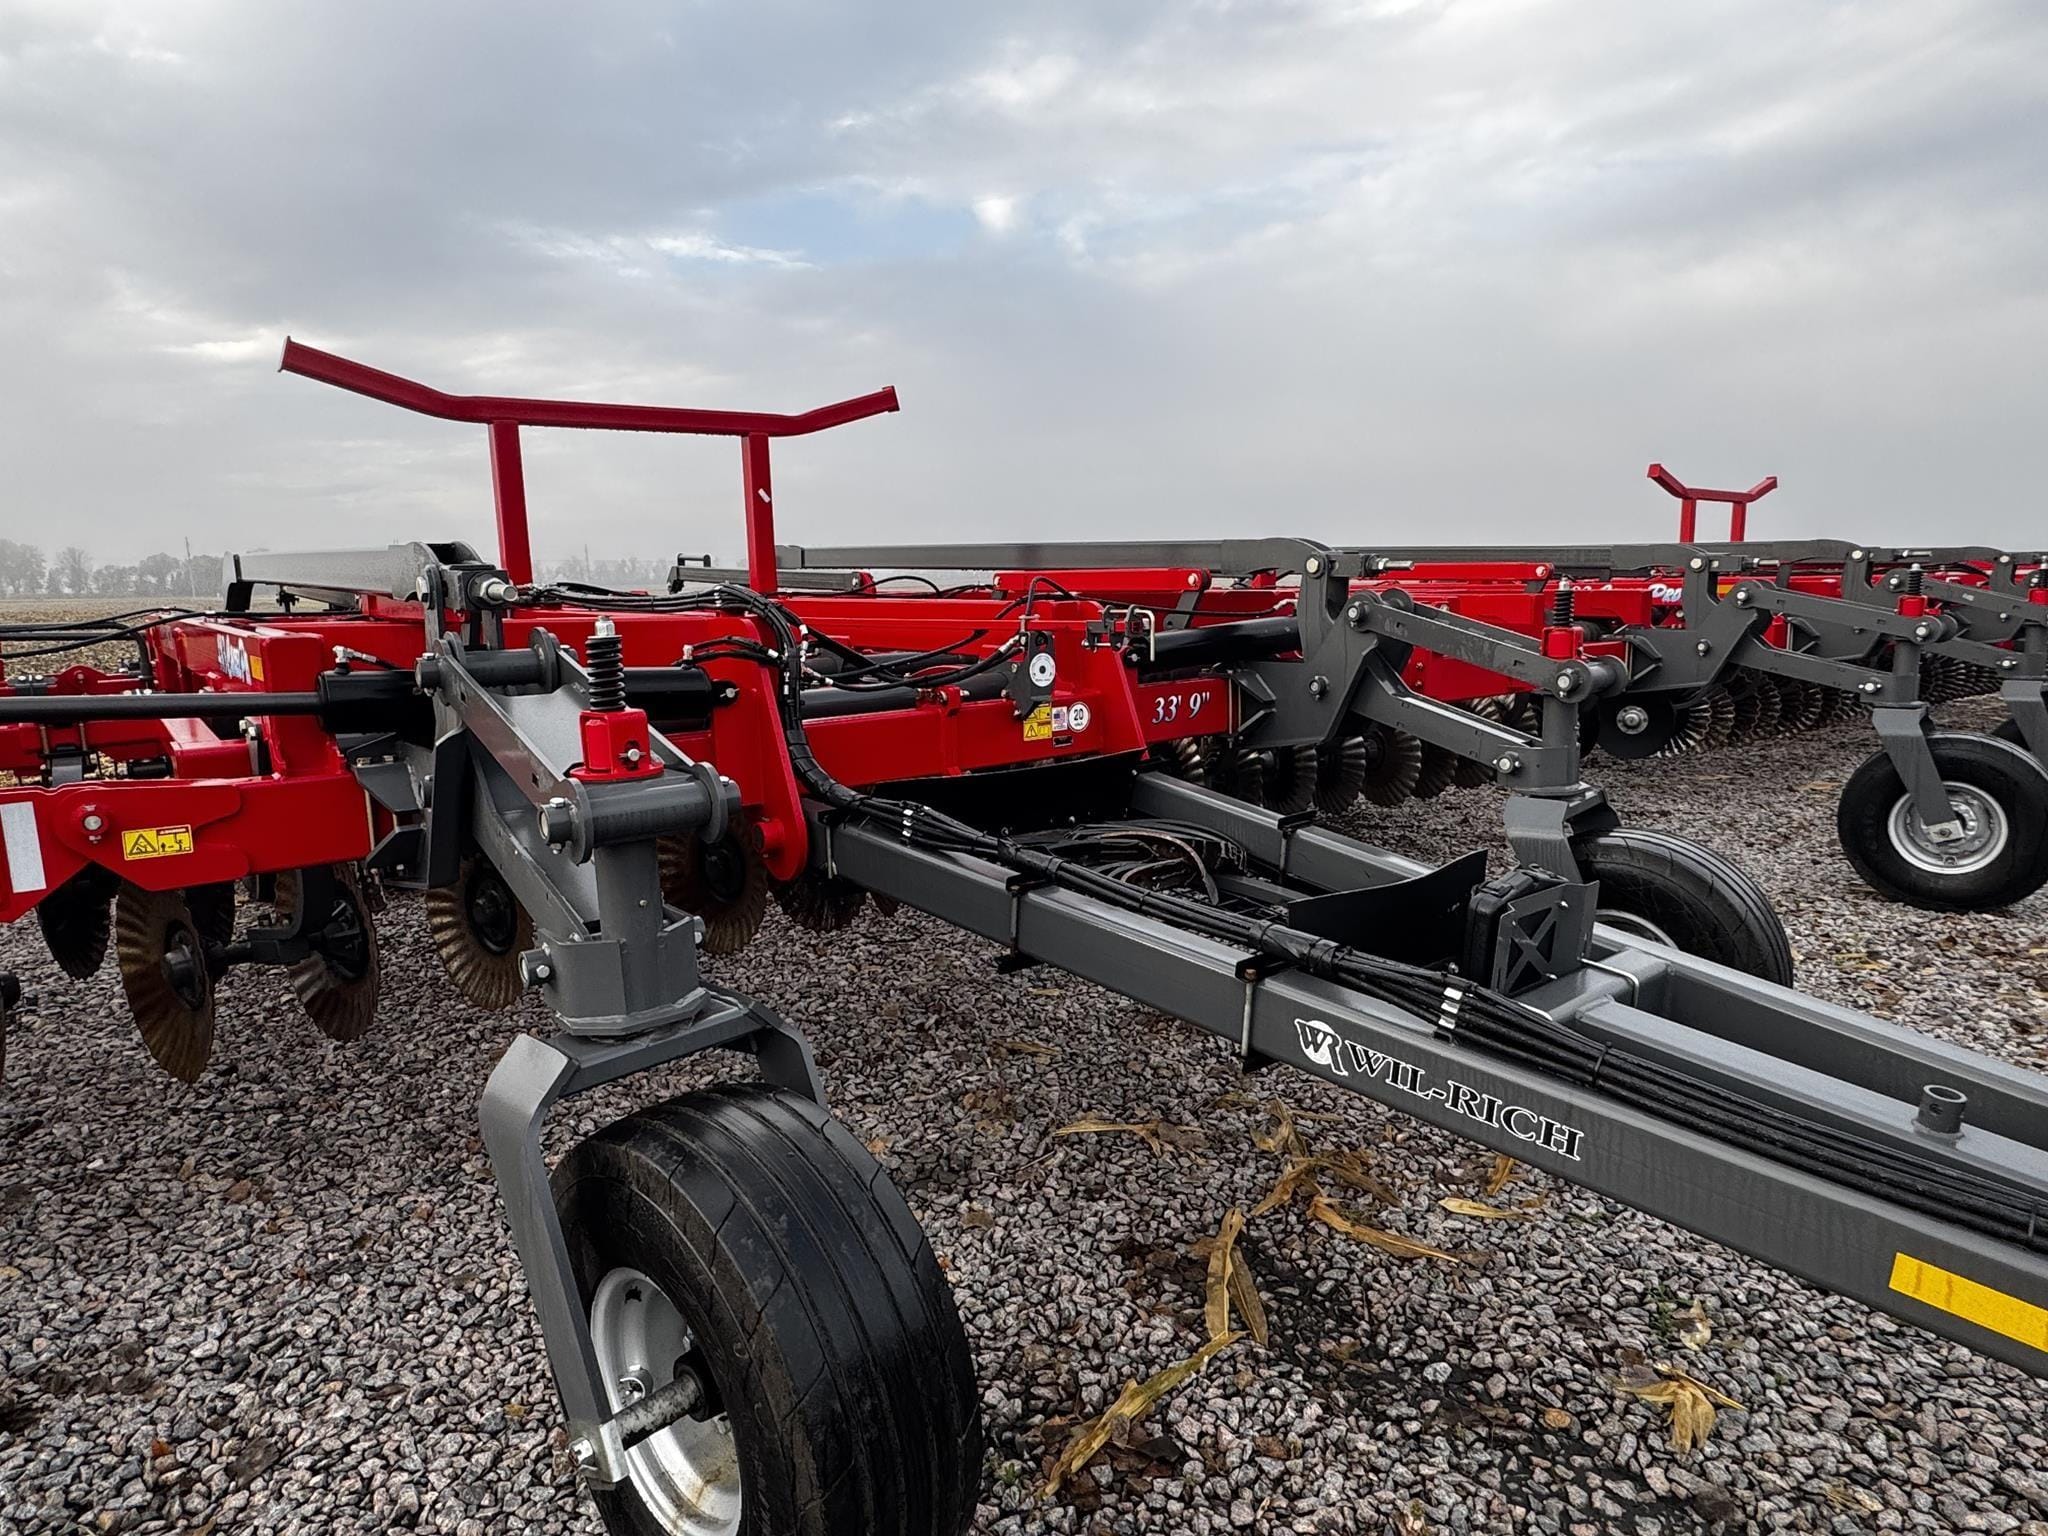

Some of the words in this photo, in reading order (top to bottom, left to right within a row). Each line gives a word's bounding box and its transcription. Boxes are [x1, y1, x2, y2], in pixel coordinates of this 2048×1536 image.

[1073, 708, 1084, 721] 20
[1152, 695, 1182, 724] 33'
[1188, 691, 1210, 719] 9"
[1345, 1040, 1585, 1161] WIL-RICH
